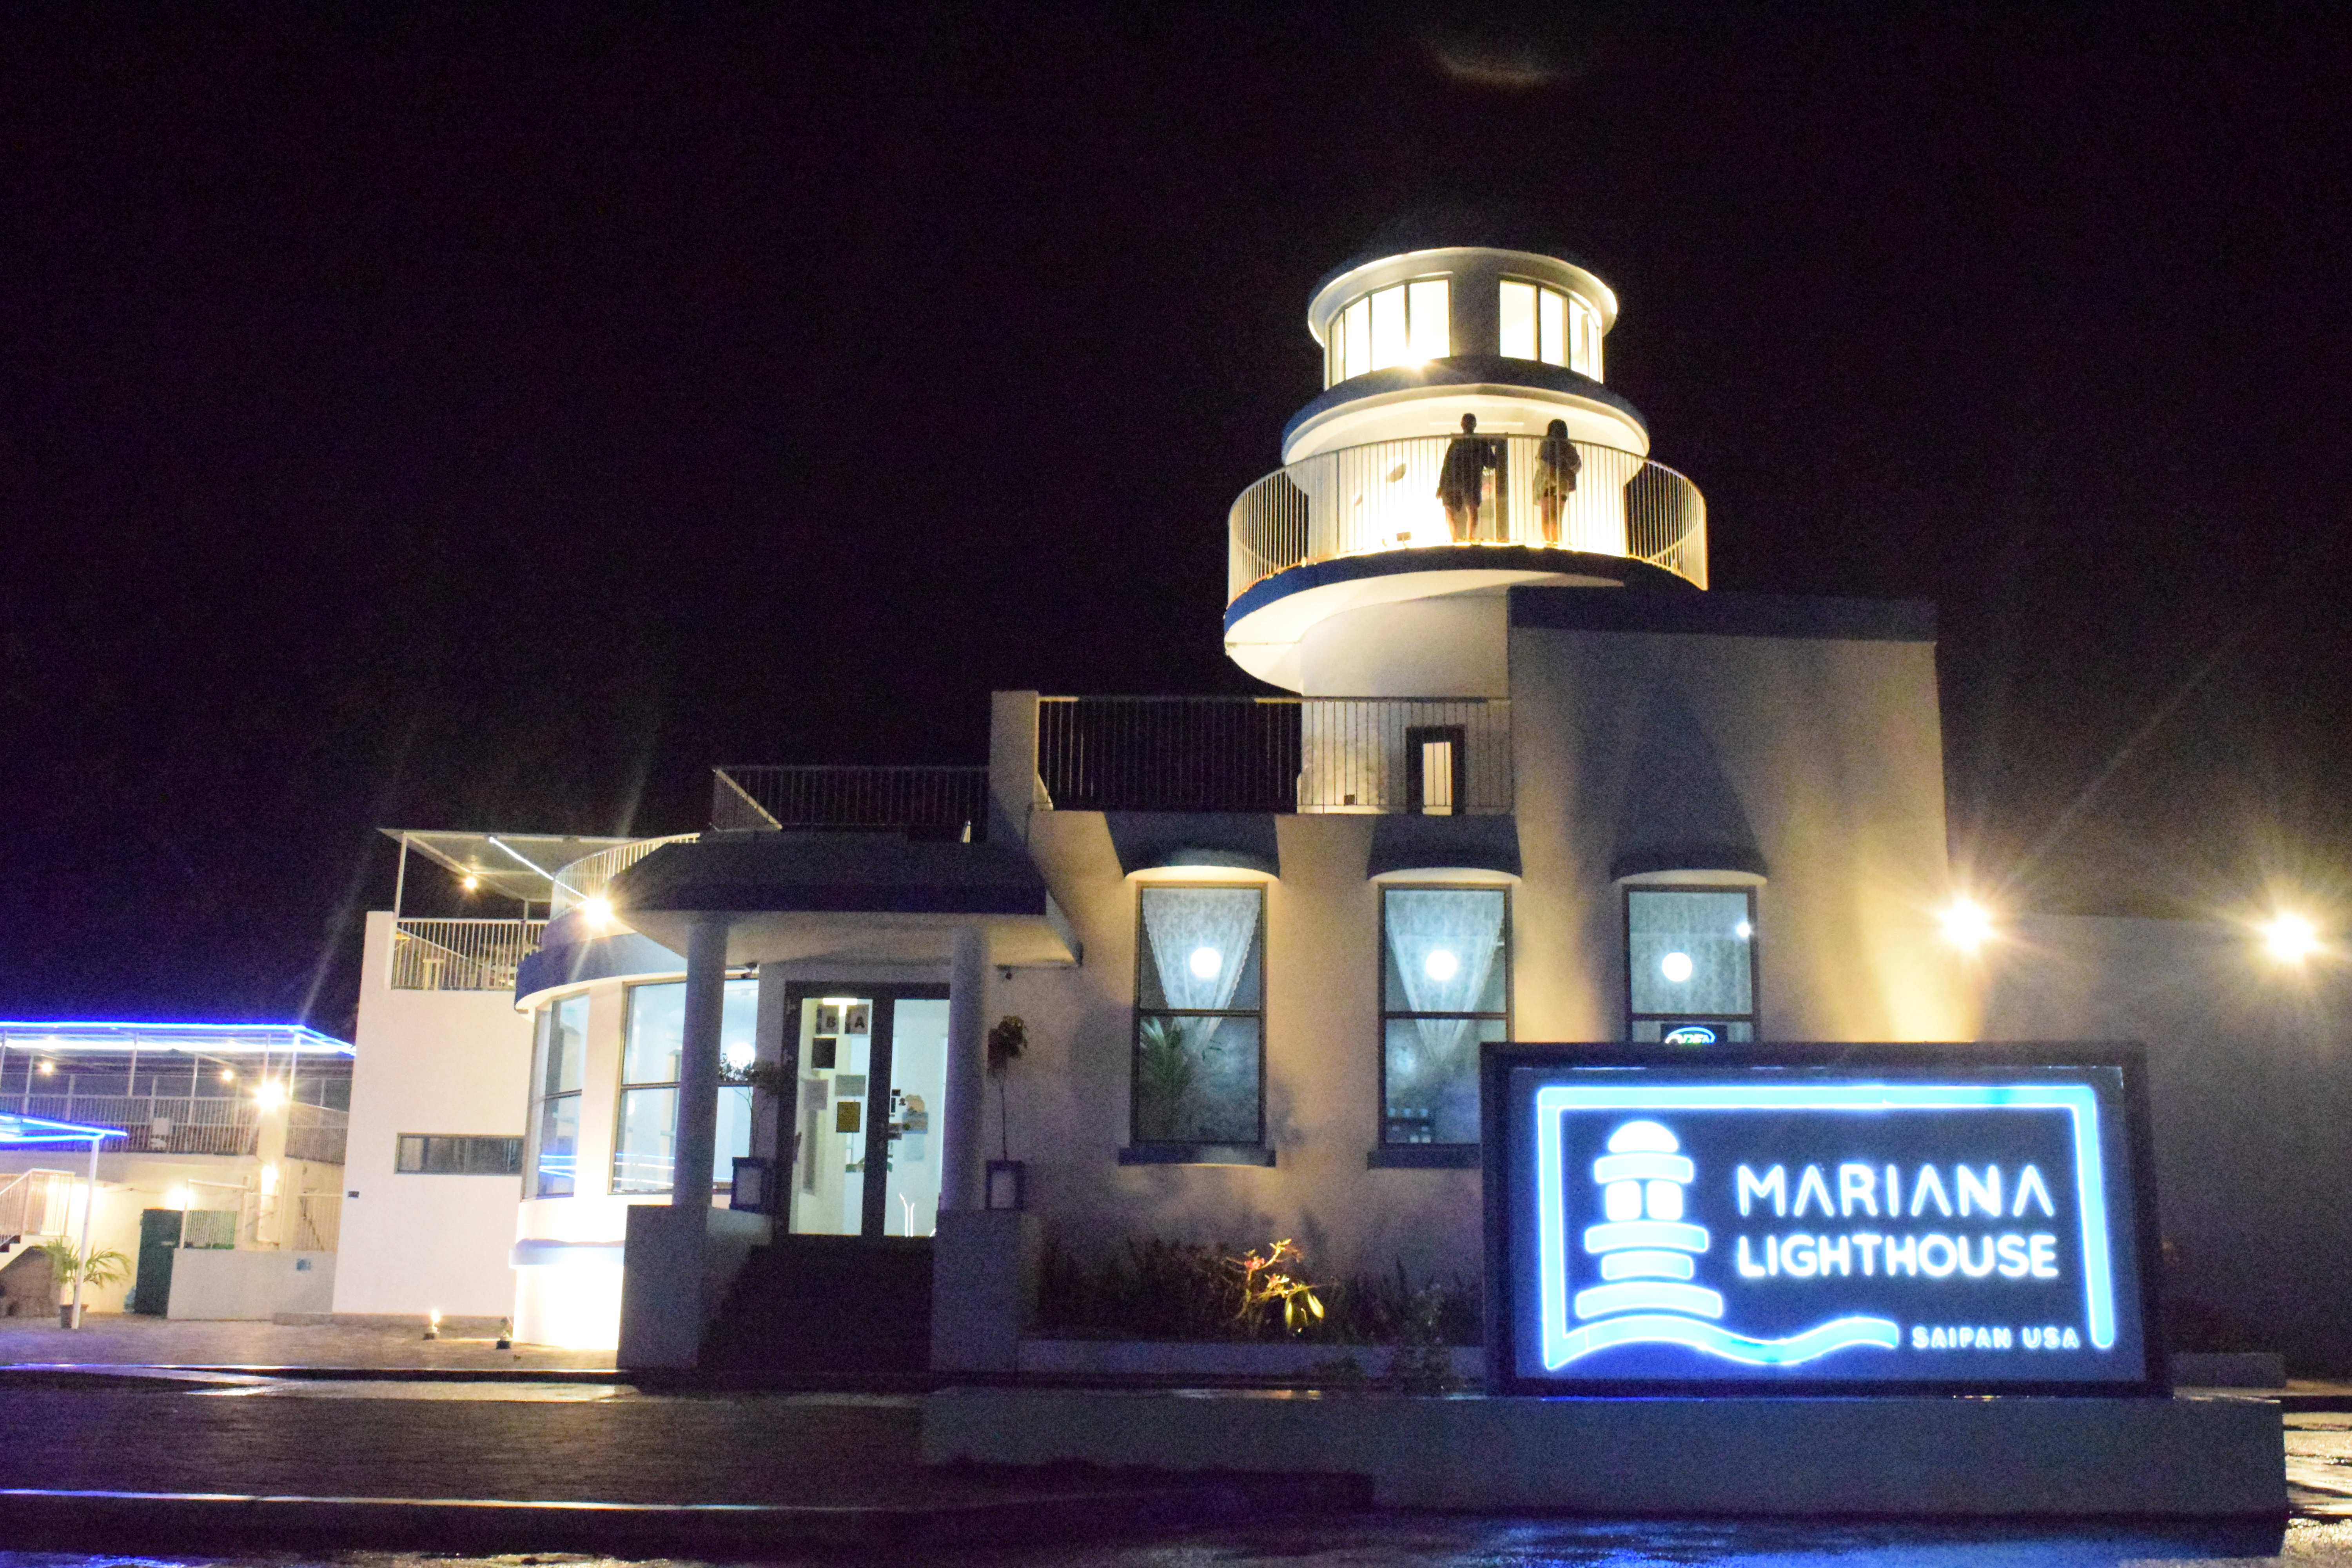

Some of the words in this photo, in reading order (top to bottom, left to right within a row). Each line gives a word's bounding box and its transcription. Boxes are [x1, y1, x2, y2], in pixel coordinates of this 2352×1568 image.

[855, 1016, 865, 1028] A
[1737, 1163, 2054, 1217] MARIANA
[1737, 1232, 2058, 1278] LIGHTHOUSE
[1912, 1326, 2012, 1349] SAIPAN
[2022, 1327, 2079, 1348] USA
